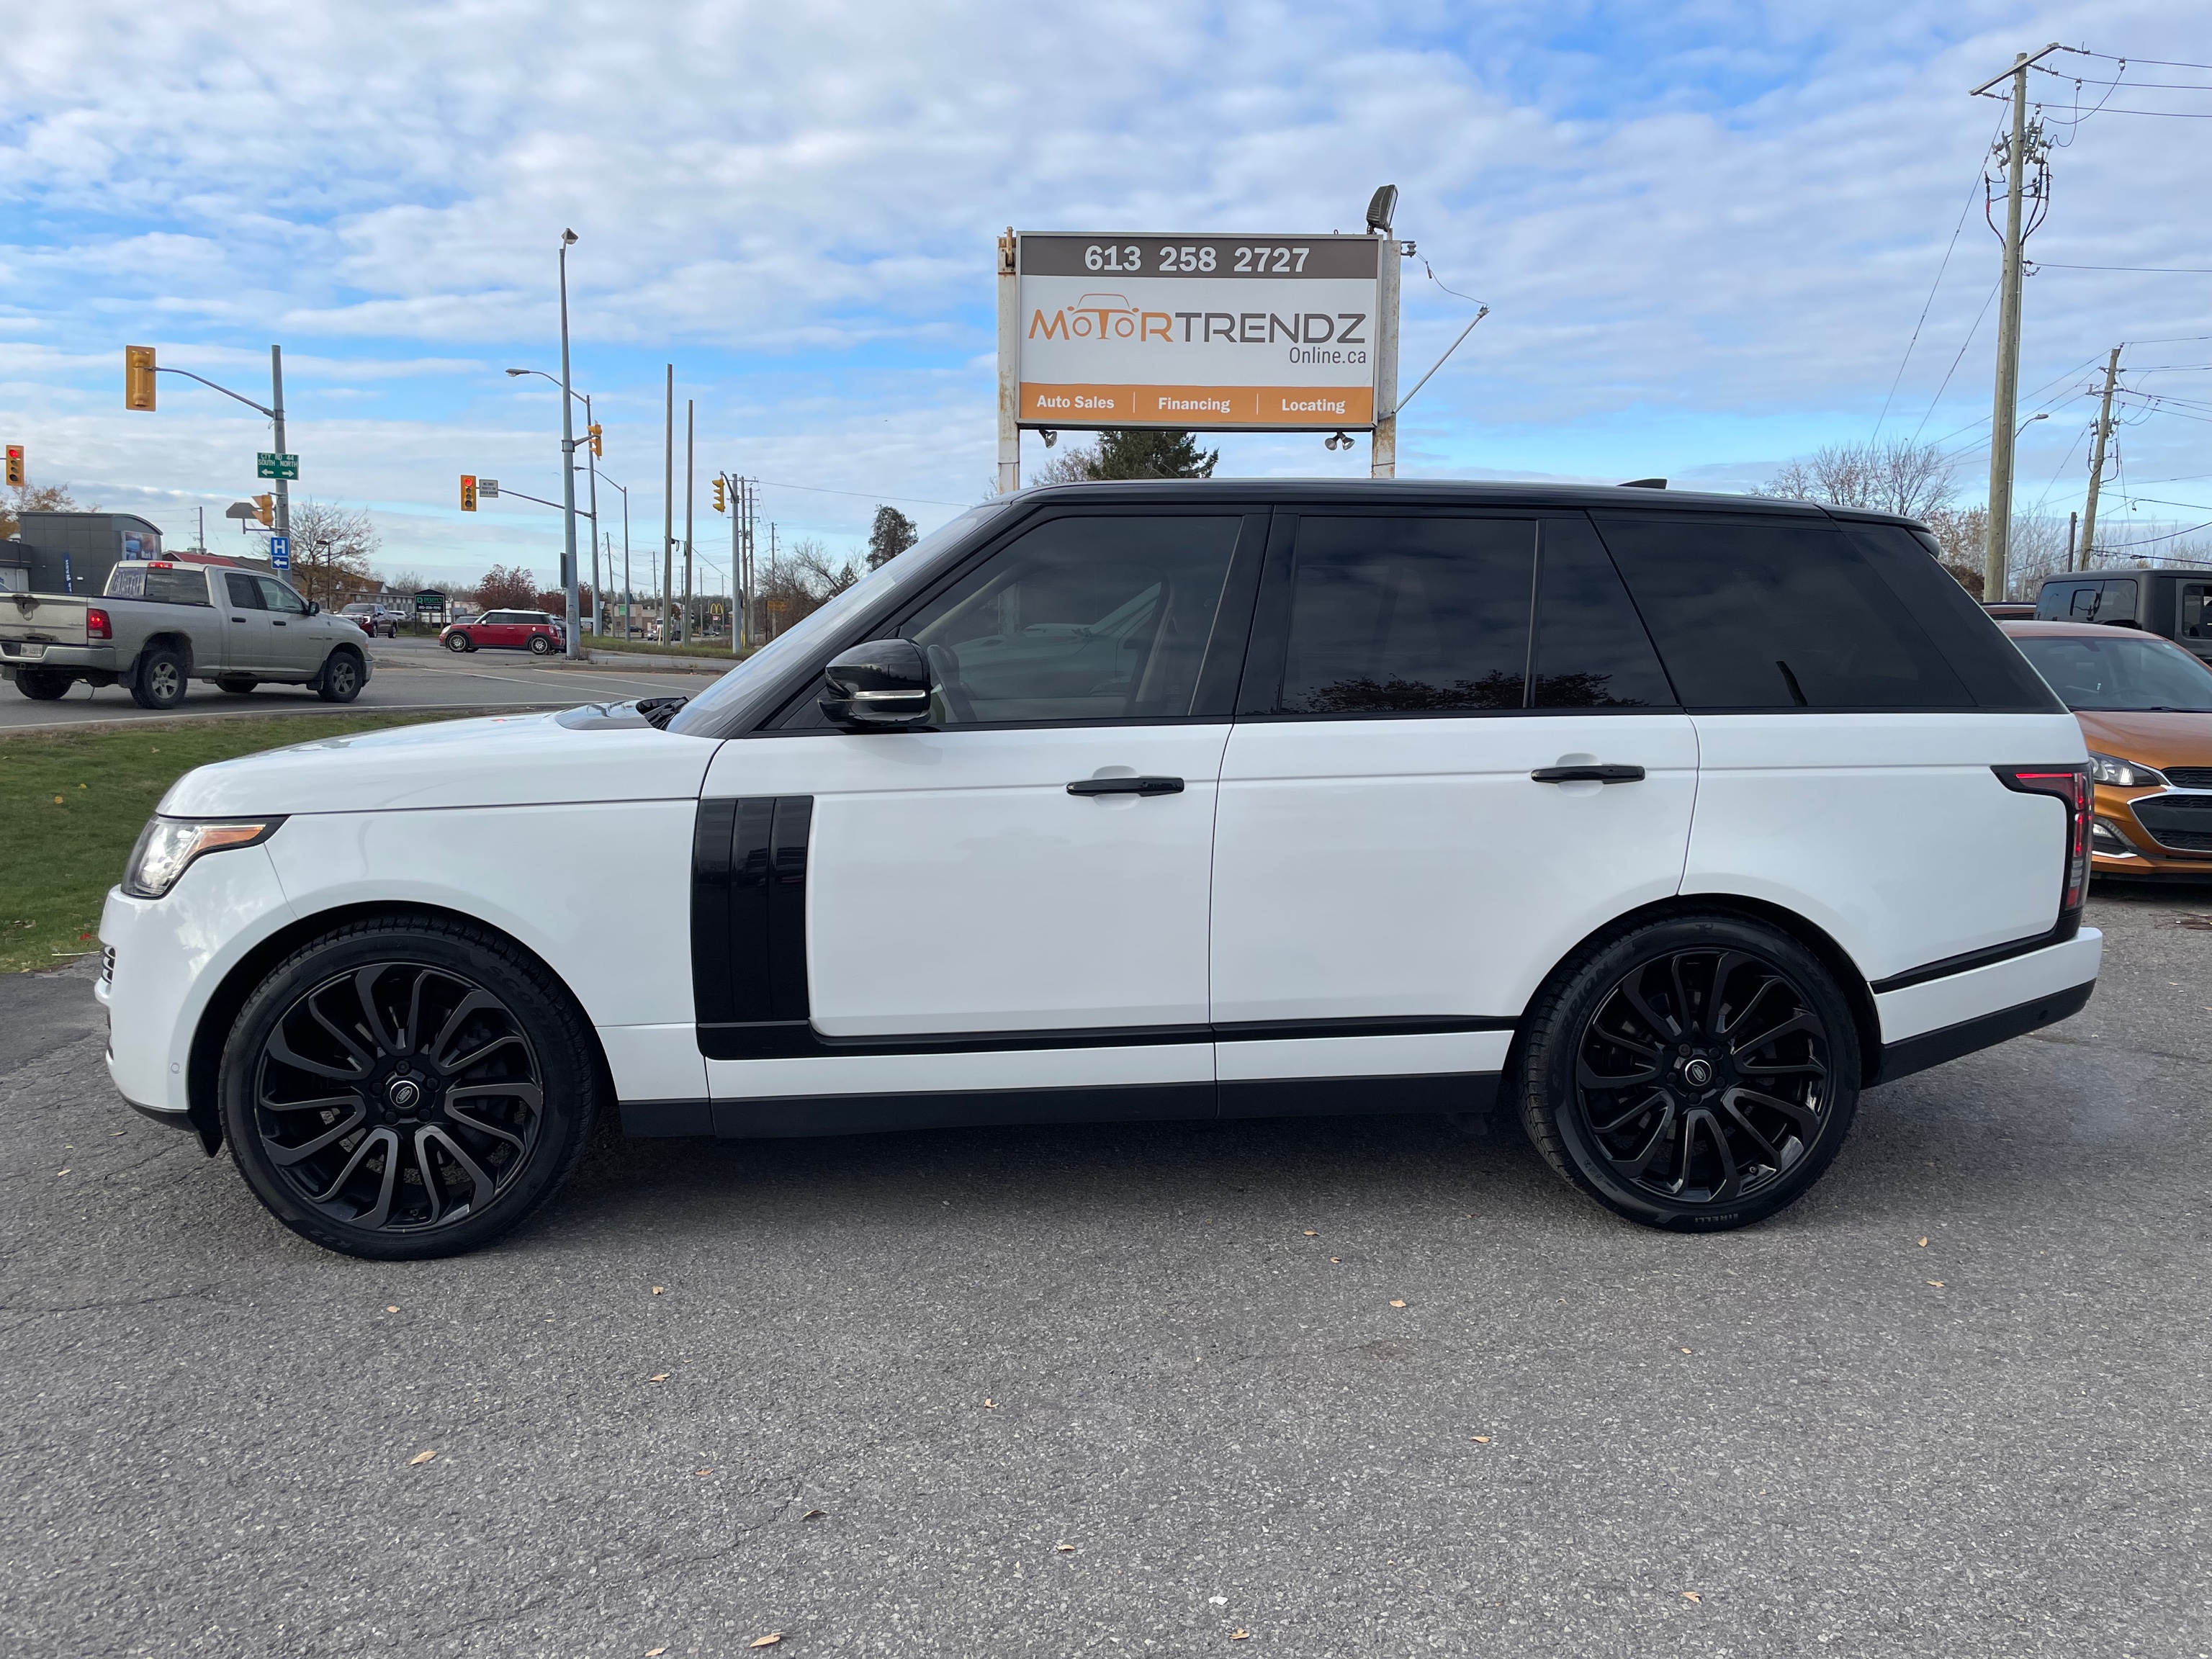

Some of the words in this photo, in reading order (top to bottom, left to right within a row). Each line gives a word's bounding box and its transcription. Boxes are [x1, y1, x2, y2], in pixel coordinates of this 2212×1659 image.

[1084, 245, 1142, 271] 613
[1159, 246, 1218, 272] 258
[1233, 247, 1310, 273] 2727
[1289, 346, 1367, 364] Online.ca
[1036, 395, 1071, 409] Auto
[1074, 395, 1115, 410] Sales
[1158, 397, 1231, 413] Financing
[1282, 398, 1346, 414] Locating
[274, 539, 286, 554] H
